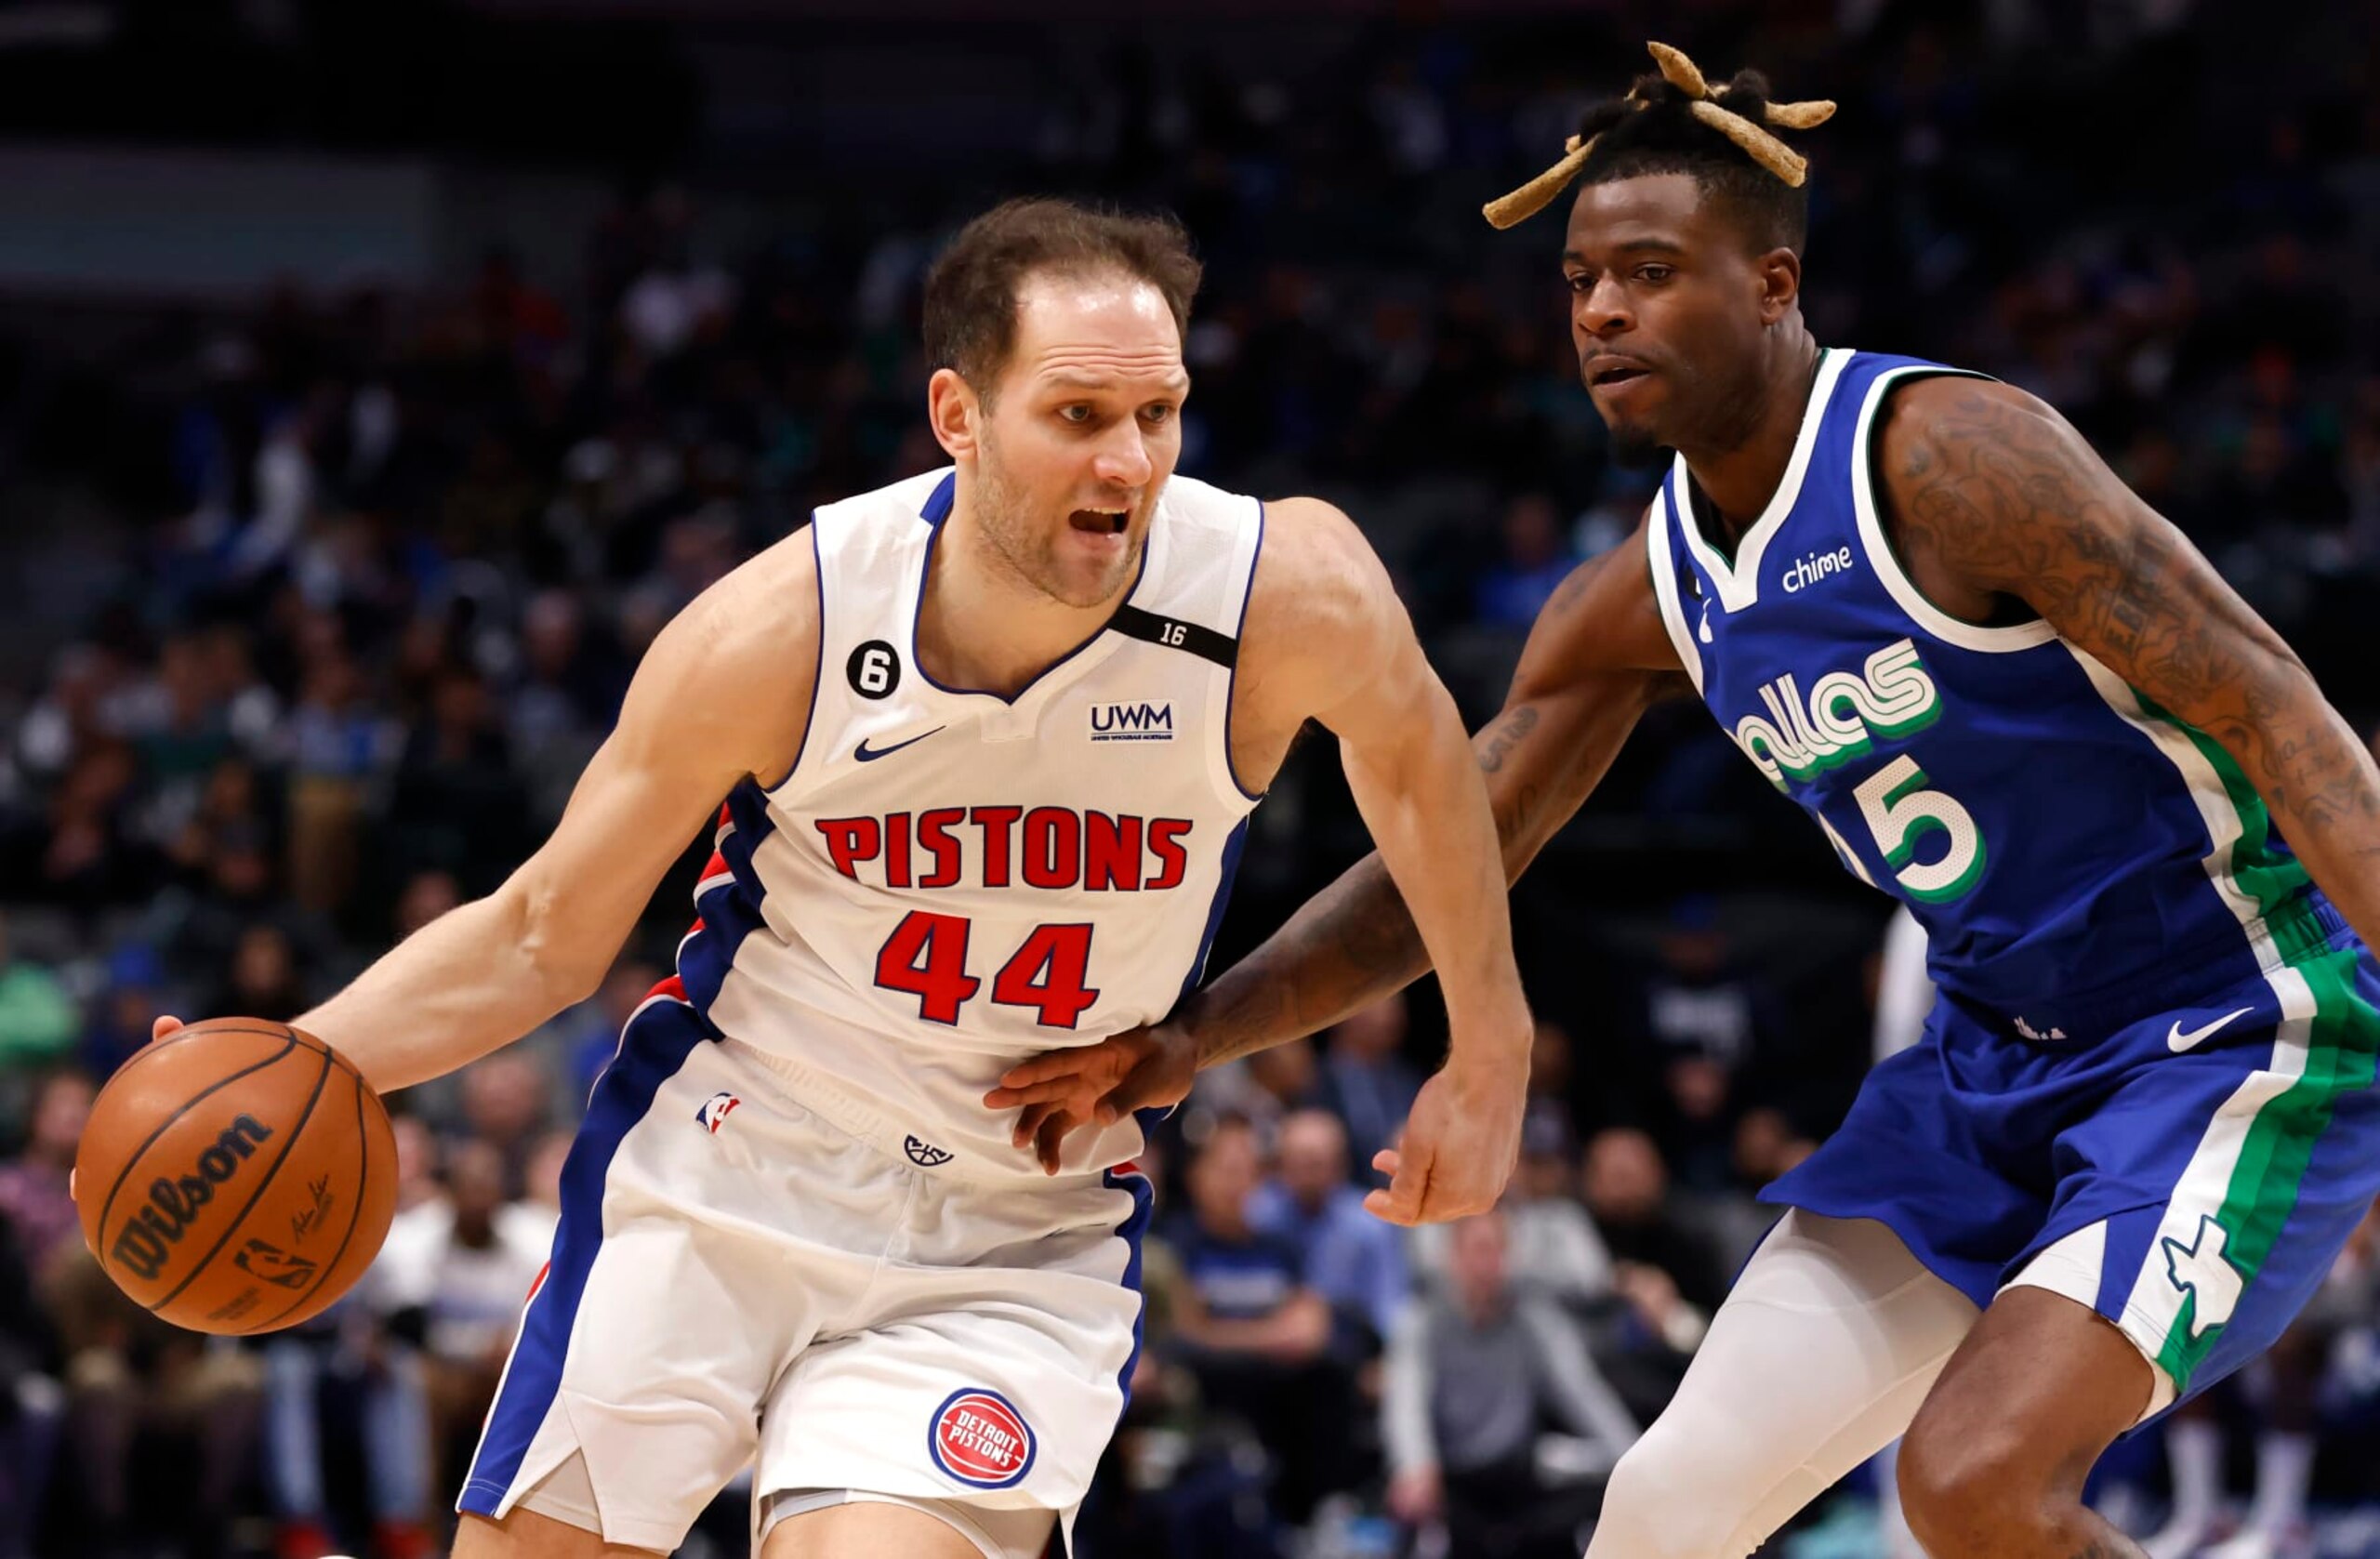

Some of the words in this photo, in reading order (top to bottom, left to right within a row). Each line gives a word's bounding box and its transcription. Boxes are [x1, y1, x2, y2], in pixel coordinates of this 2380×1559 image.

[1781, 546, 1854, 593] chime
[1160, 622, 1187, 646] 16
[858, 650, 892, 694] 6
[1091, 703, 1173, 732] UWM
[1726, 638, 1942, 792] allas
[813, 804, 1194, 892] PISTONS
[1818, 754, 1986, 902] 5
[874, 909, 1100, 1030] 44
[112, 1113, 274, 1280] Wilson
[947, 1424, 1012, 1468] PISTONS
[956, 1409, 1019, 1453] DETROIT
